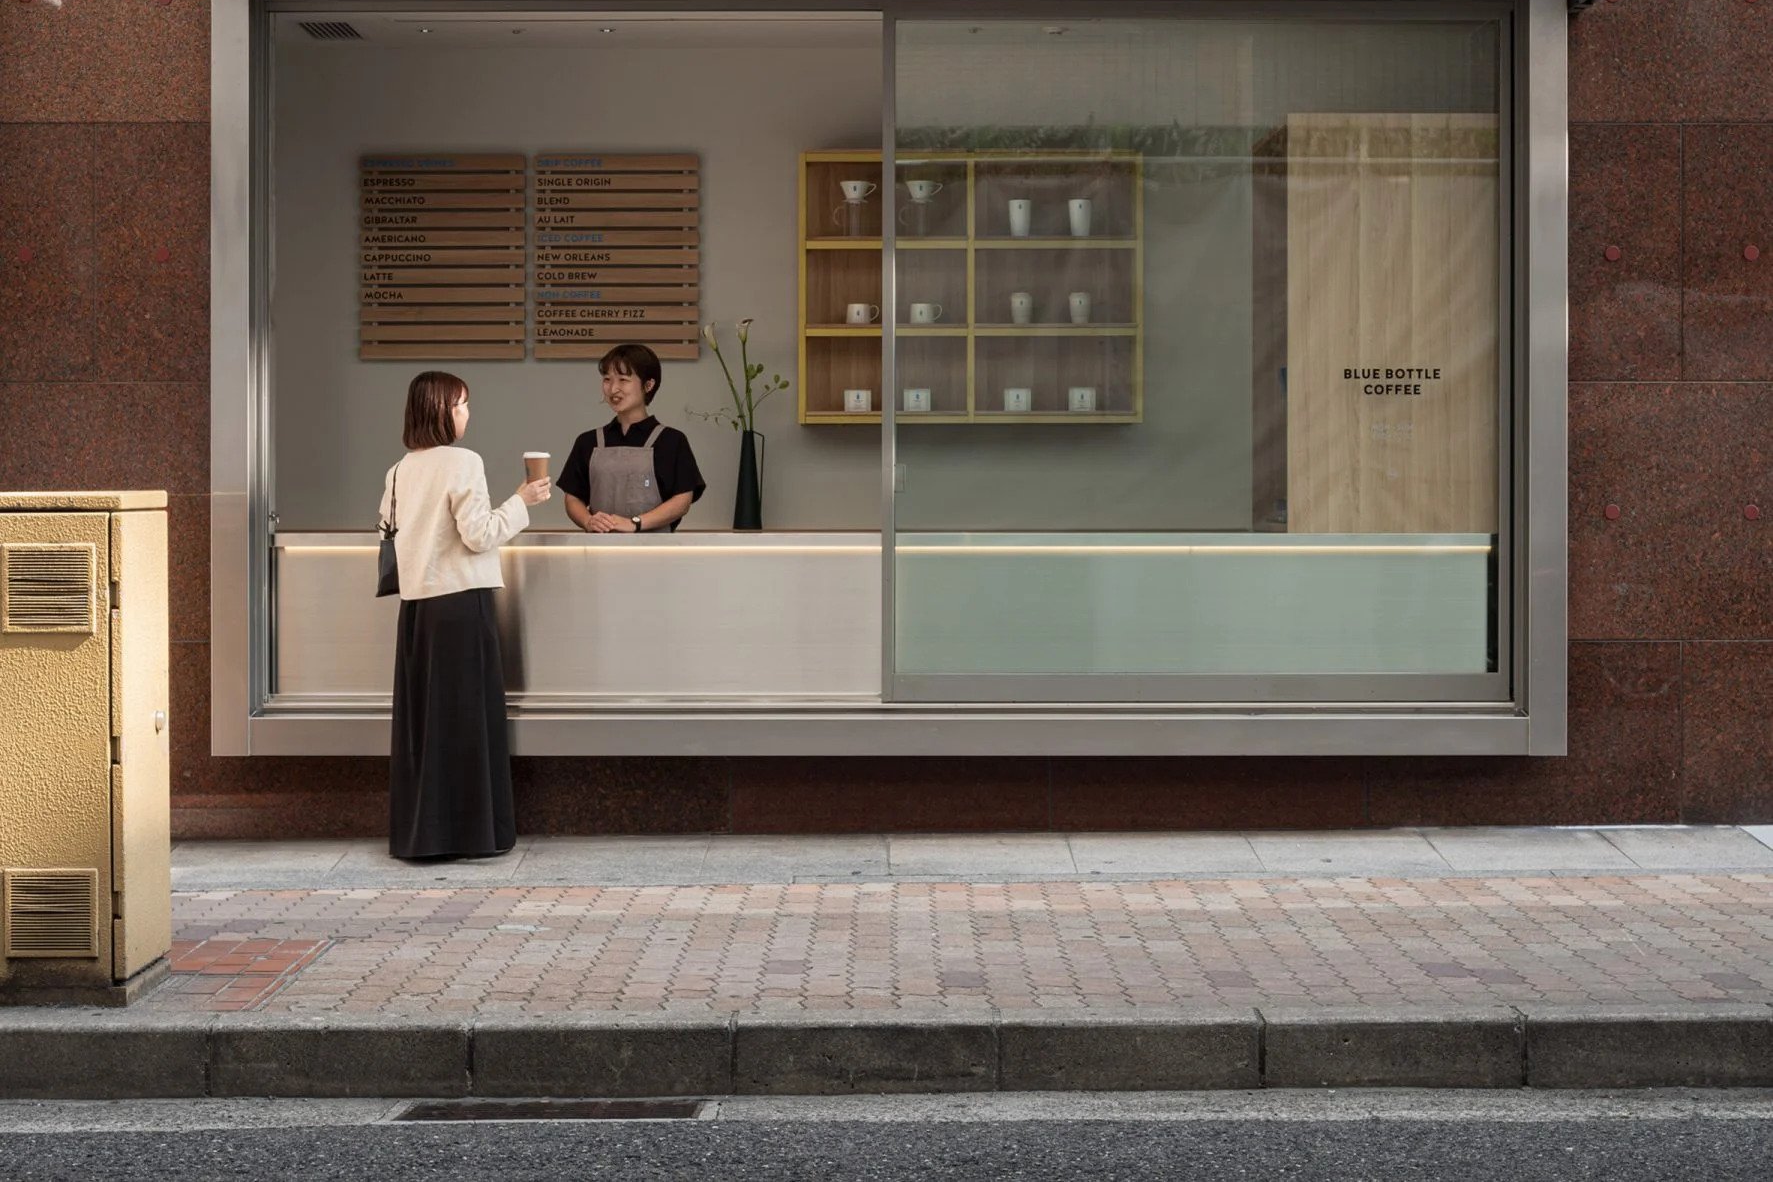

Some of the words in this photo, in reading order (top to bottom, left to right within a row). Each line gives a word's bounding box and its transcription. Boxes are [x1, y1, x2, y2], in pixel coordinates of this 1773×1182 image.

[363, 178, 416, 187] ESPRESSO
[537, 178, 573, 187] SINGLE
[575, 178, 611, 187] ORIGIN
[364, 196, 426, 205] MACCHIATO
[537, 197, 570, 205] BLEND
[363, 216, 418, 225] GIBRALTAR
[537, 215, 551, 224] AU
[553, 215, 576, 224] LAIT
[364, 234, 426, 243] AMERICANO
[537, 234, 561, 243] ICED
[564, 234, 603, 243] COFFEE
[364, 254, 432, 262] CAPPUCCINO
[537, 253, 561, 261] NEW
[564, 253, 611, 261] ORLEANS
[363, 272, 393, 281] LATTE
[537, 272, 565, 281] COLD
[568, 272, 598, 280] BREW
[364, 291, 404, 300] MOCHA
[537, 309, 577, 318] COFFEE
[579, 309, 620, 318] CHERRY
[623, 309, 645, 318] FIZZ
[537, 328, 595, 337] LEMONADE
[1343, 368, 1381, 380] BLUE
[1385, 368, 1441, 380] BOTTLE
[1363, 384, 1422, 395] COFFEE
